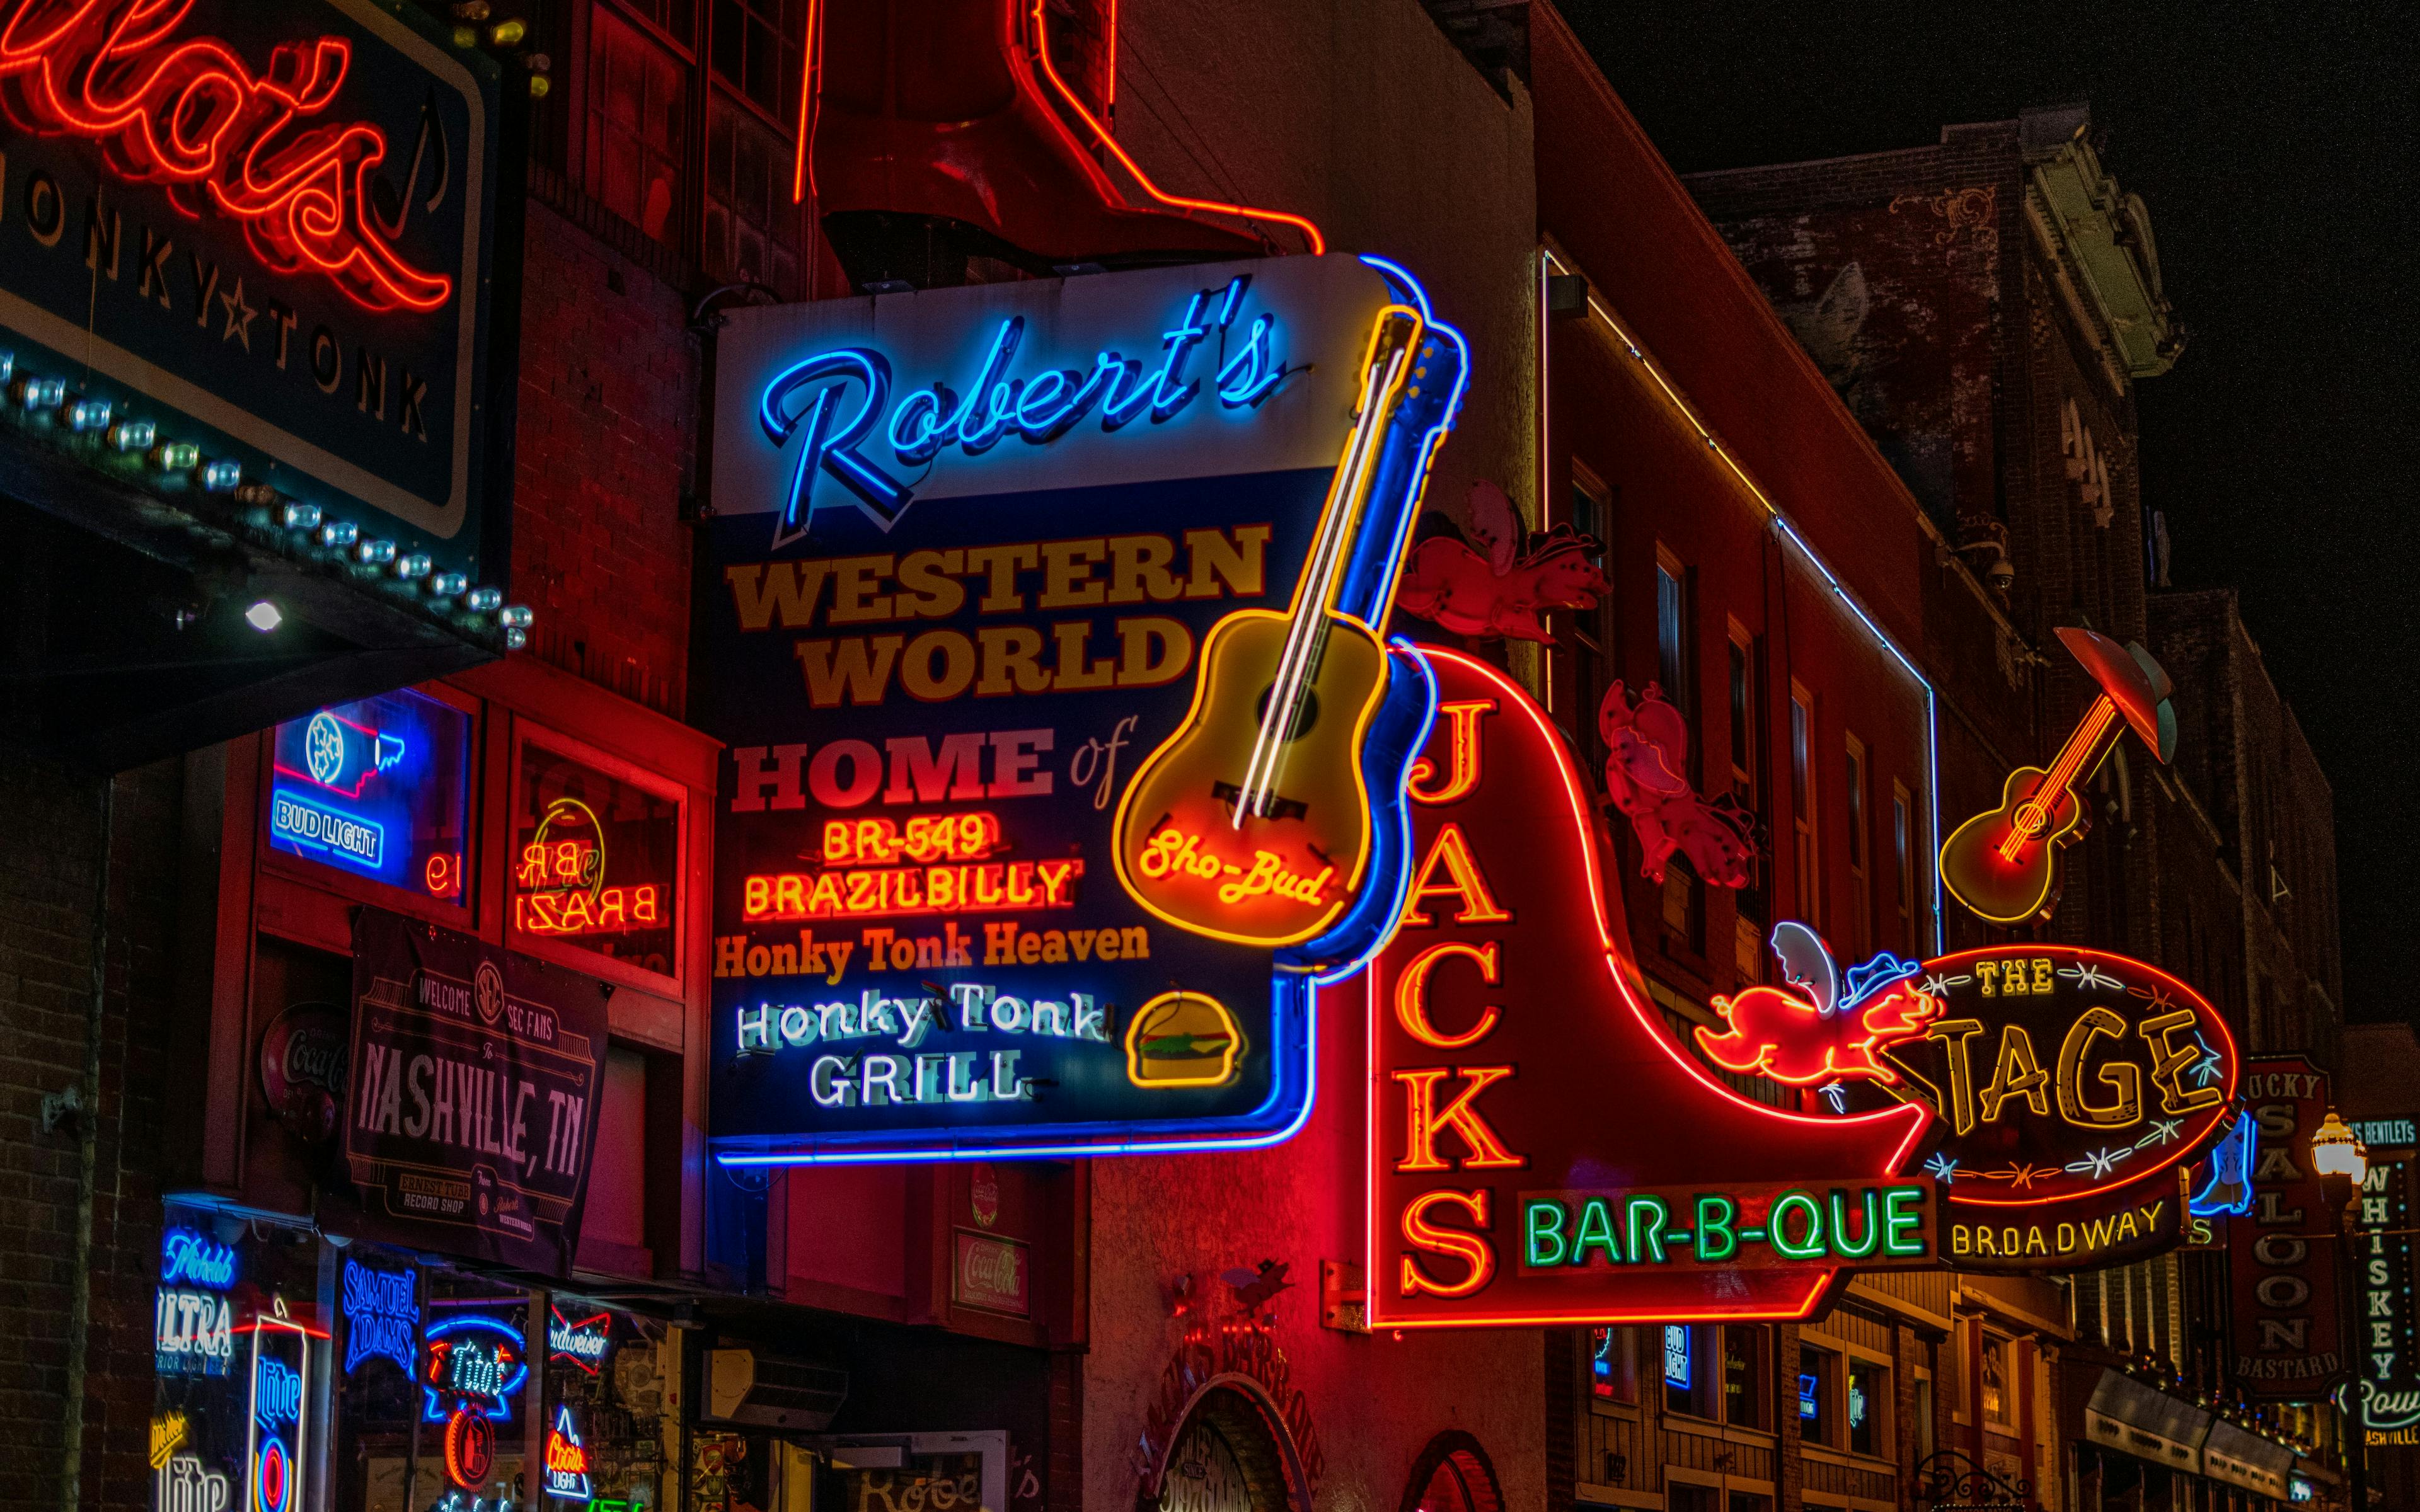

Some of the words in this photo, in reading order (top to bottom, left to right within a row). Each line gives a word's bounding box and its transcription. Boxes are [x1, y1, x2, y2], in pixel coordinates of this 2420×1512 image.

[0, 151, 218, 328] ONKY
[268, 297, 427, 443] TONK
[760, 274, 1279, 536] Robert's
[725, 523, 1272, 632] WESTERN
[795, 616, 1195, 709] WORLD
[732, 728, 1054, 812] HOME
[1071, 714, 1138, 810] of
[276, 800, 321, 839] BUD
[322, 815, 377, 857] LIGHT
[823, 813, 998, 866] BR-549
[744, 861, 1083, 920] BRAZILBILLY
[1139, 828, 1334, 907] Sho-Bud
[714, 929, 853, 985] Honky
[863, 923, 972, 972] Tonk
[983, 922, 1150, 966] Heaven
[1976, 958, 2054, 997] THE
[419, 977, 471, 1017] WELCOME
[507, 1004, 524, 1033] SEC
[526, 1011, 553, 1041] FANS
[737, 990, 930, 1048] Honky
[950, 982, 1107, 1041] Tonk
[1392, 698, 1528, 1299] JACKS
[482, 1042, 493, 1059] To
[810, 1050, 1031, 1107] GRILL
[357, 1041, 537, 1178] NASHVILLE,
[544, 1089, 584, 1176] TN
[2249, 1072, 2321, 1099] UCKY
[401, 1175, 443, 1194] ERNEST
[443, 1182, 470, 1199] TUBB
[403, 1193, 439, 1211] RECORD
[441, 1199, 464, 1214] SHOP
[476, 1169, 492, 1188] From
[499, 1213, 521, 1228] WESTERN
[520, 1220, 533, 1232] WORLD
[1524, 1185, 1925, 1267] BAR-B-QUE
[1952, 1200, 2165, 1255] BROADWAY
[2254, 1103, 2307, 1353] SALOON
[343, 1257, 419, 1322] SAMUEL
[964, 1242, 1021, 1297] Coca-Cola
[2362, 1166, 2393, 1380] WHISKEY
[345, 1313, 417, 1382] ADAMS
[550, 1322, 607, 1355] udweiser
[1665, 1326, 1685, 1353] BUD
[2237, 1351, 2339, 1380] BASTARD
[256, 1356, 302, 1433] Lite
[548, 1432, 584, 1474] Coors
[2365, 1425, 2420, 1446] ASHVILLE
